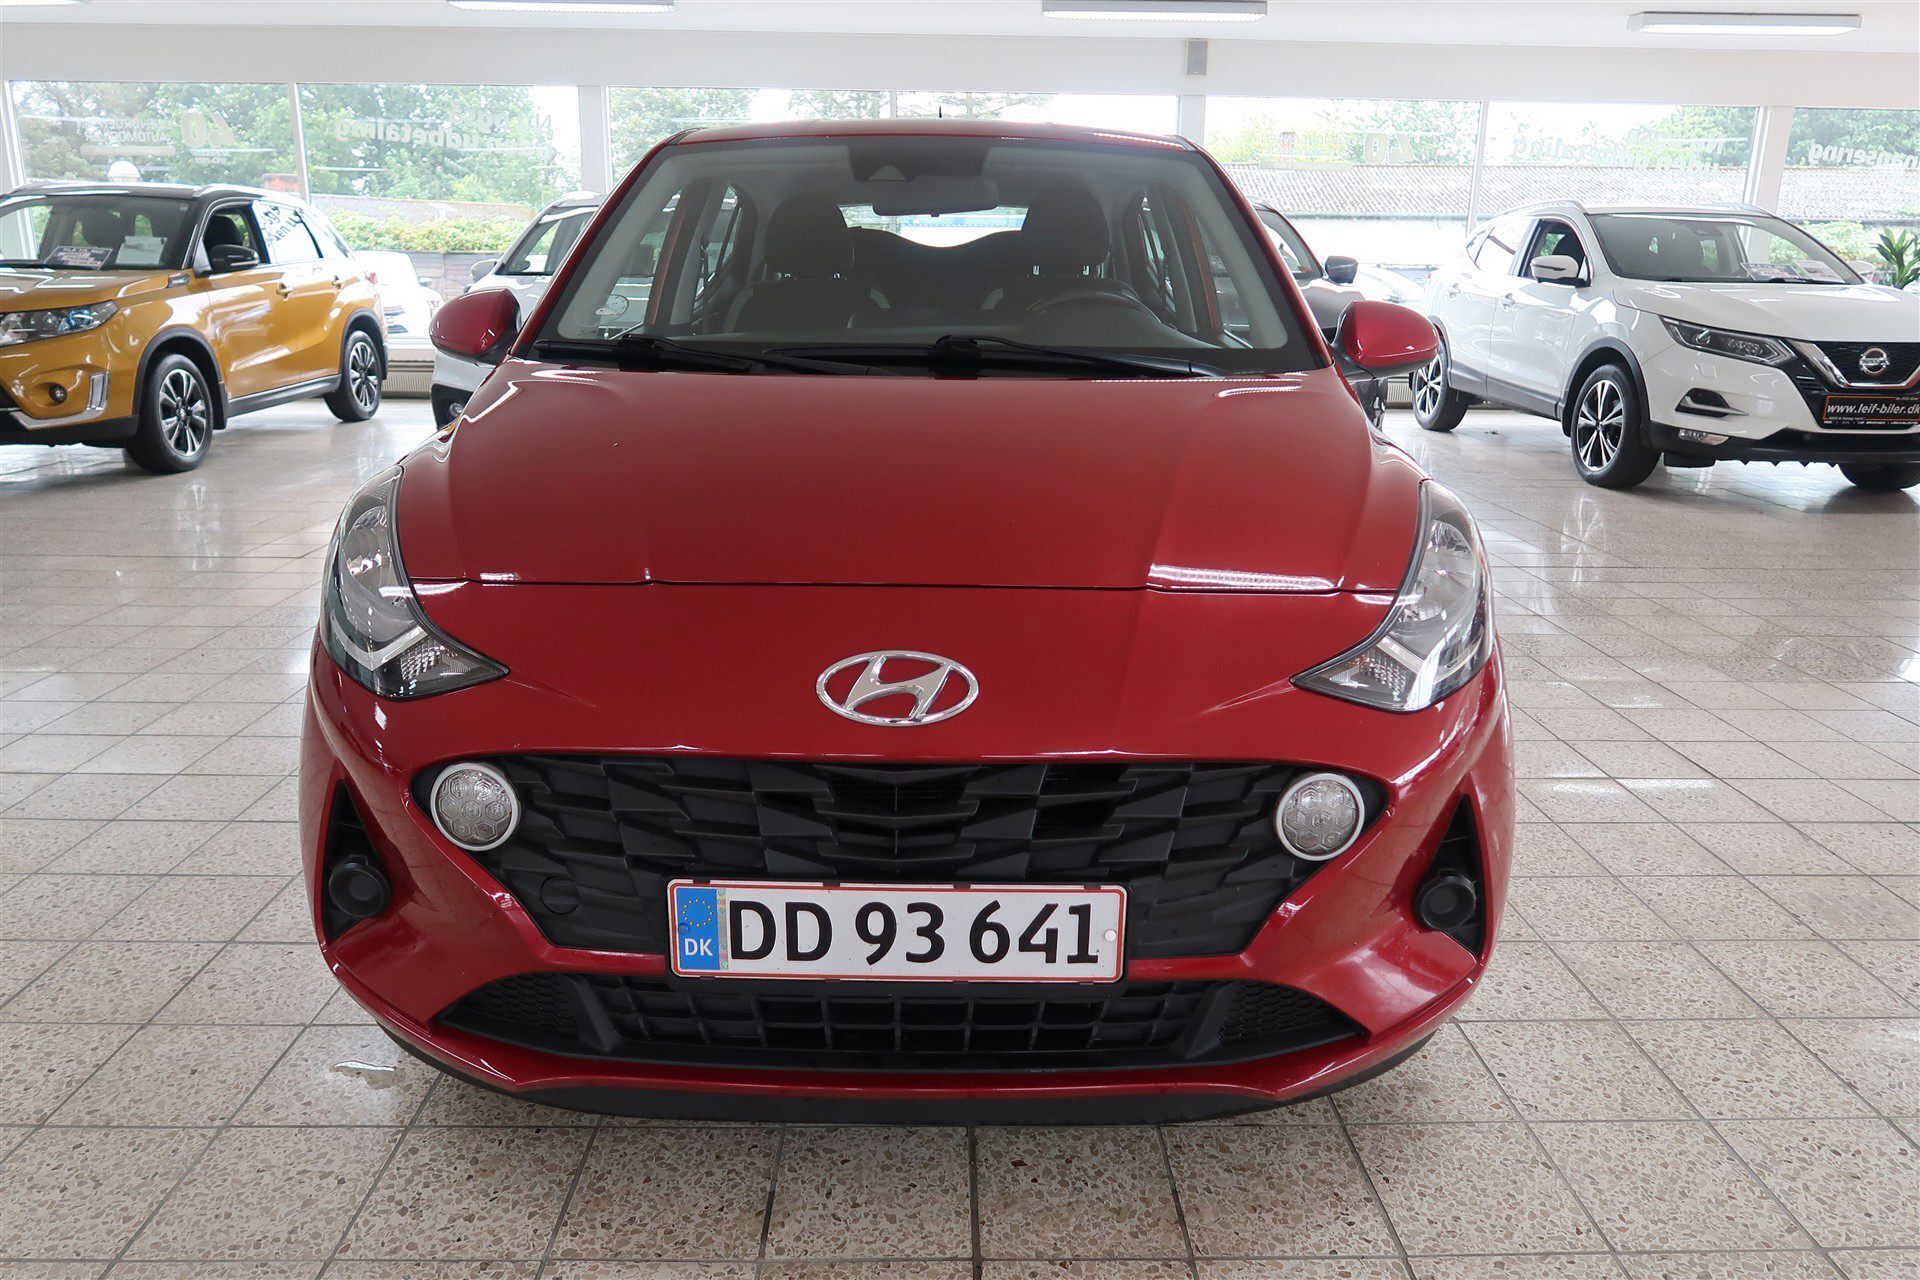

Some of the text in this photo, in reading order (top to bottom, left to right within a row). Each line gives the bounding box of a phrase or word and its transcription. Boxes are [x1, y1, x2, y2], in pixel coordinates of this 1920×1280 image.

[1827, 403, 1920, 414] www.leif-biler.dk
[729, 899, 1099, 966] DD 93 641
[684, 938, 714, 957] DK
